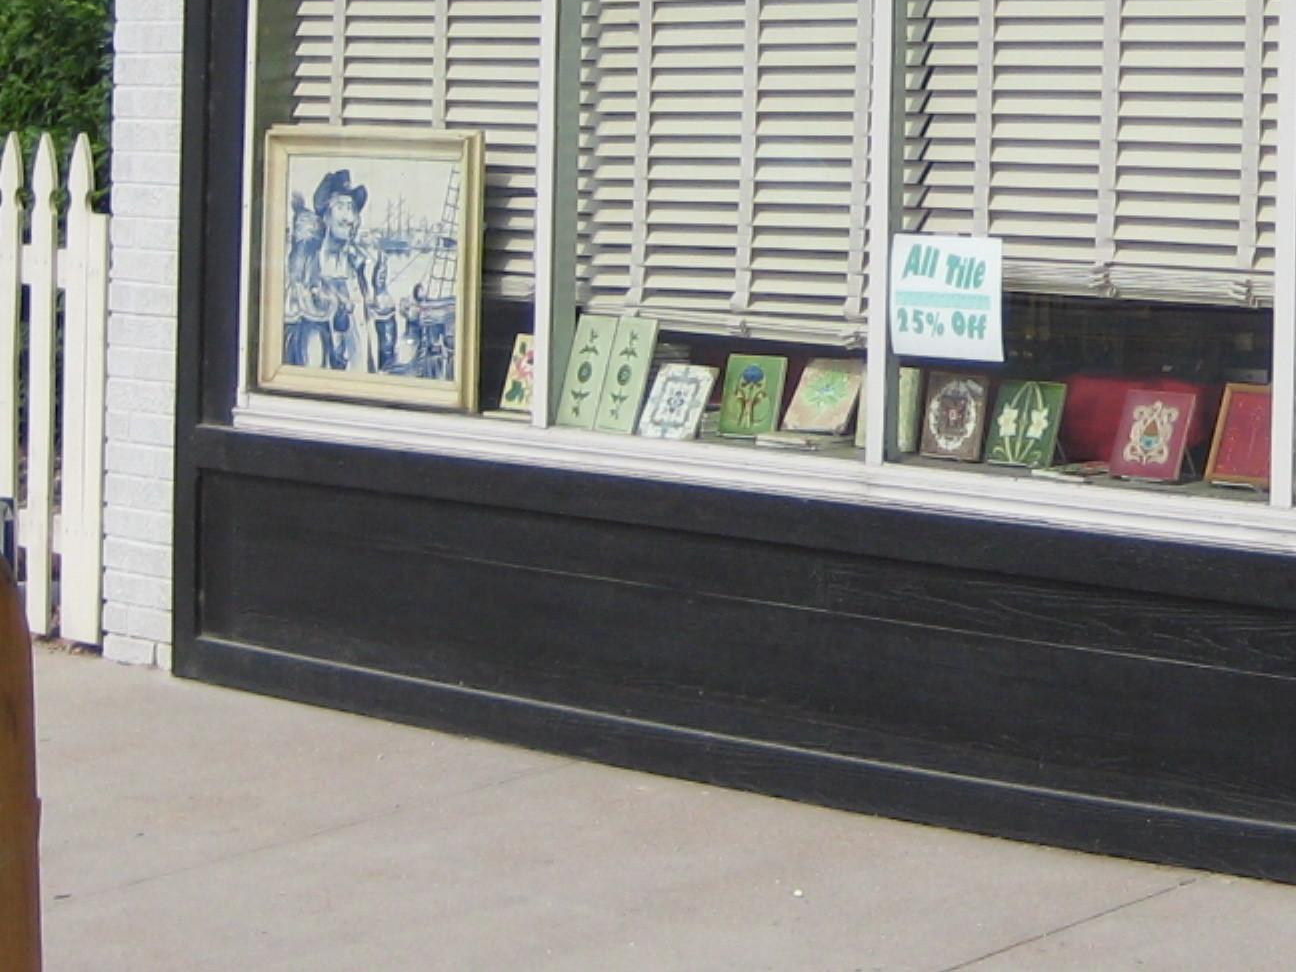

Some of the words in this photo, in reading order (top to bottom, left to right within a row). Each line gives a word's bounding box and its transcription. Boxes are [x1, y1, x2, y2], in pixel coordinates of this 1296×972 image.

[902, 243, 940, 279] All
[945, 253, 986, 289] Tile
[897, 307, 944, 338] 25%
